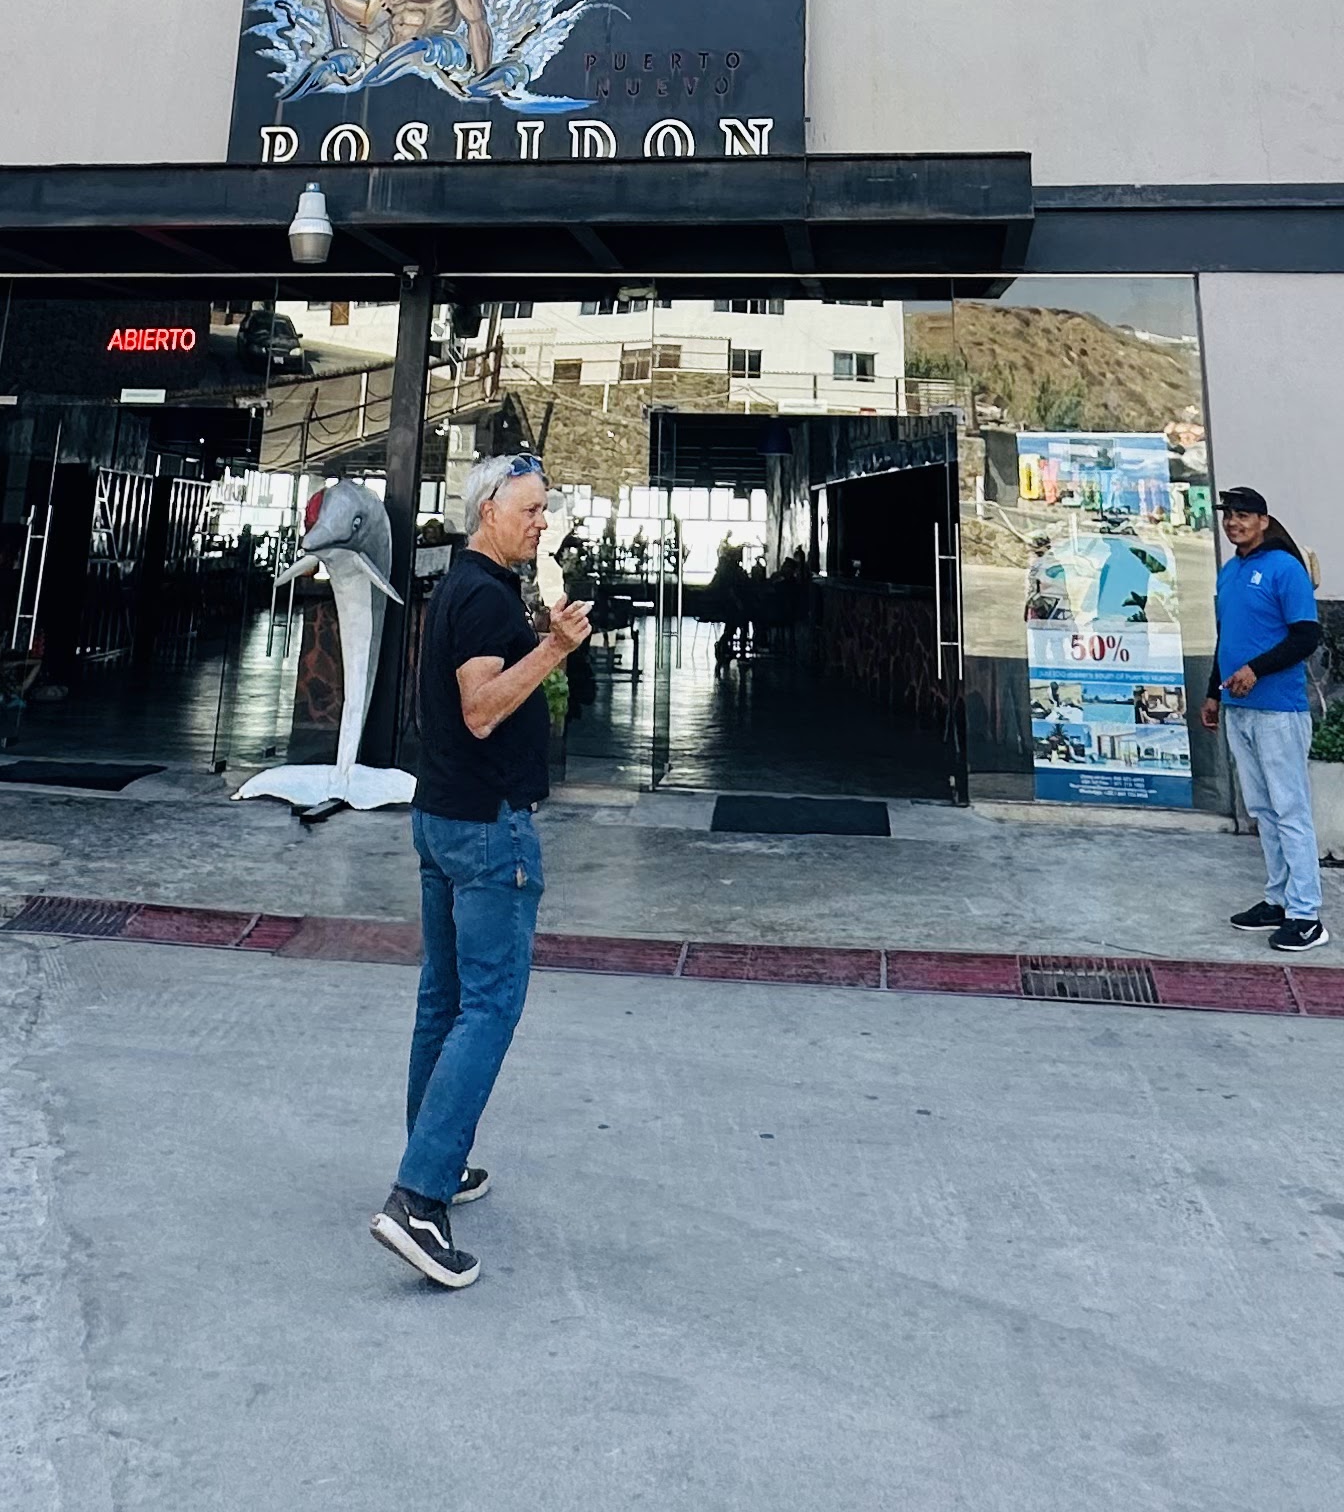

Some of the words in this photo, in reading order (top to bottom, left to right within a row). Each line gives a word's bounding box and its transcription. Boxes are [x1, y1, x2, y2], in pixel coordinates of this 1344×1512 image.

[584, 50, 742, 74] PUERTO
[594, 76, 730, 98] NUEVO
[260, 118, 774, 162] POSEIDON
[106, 328, 196, 351] ABIERTO
[1070, 634, 1130, 662] 50%
